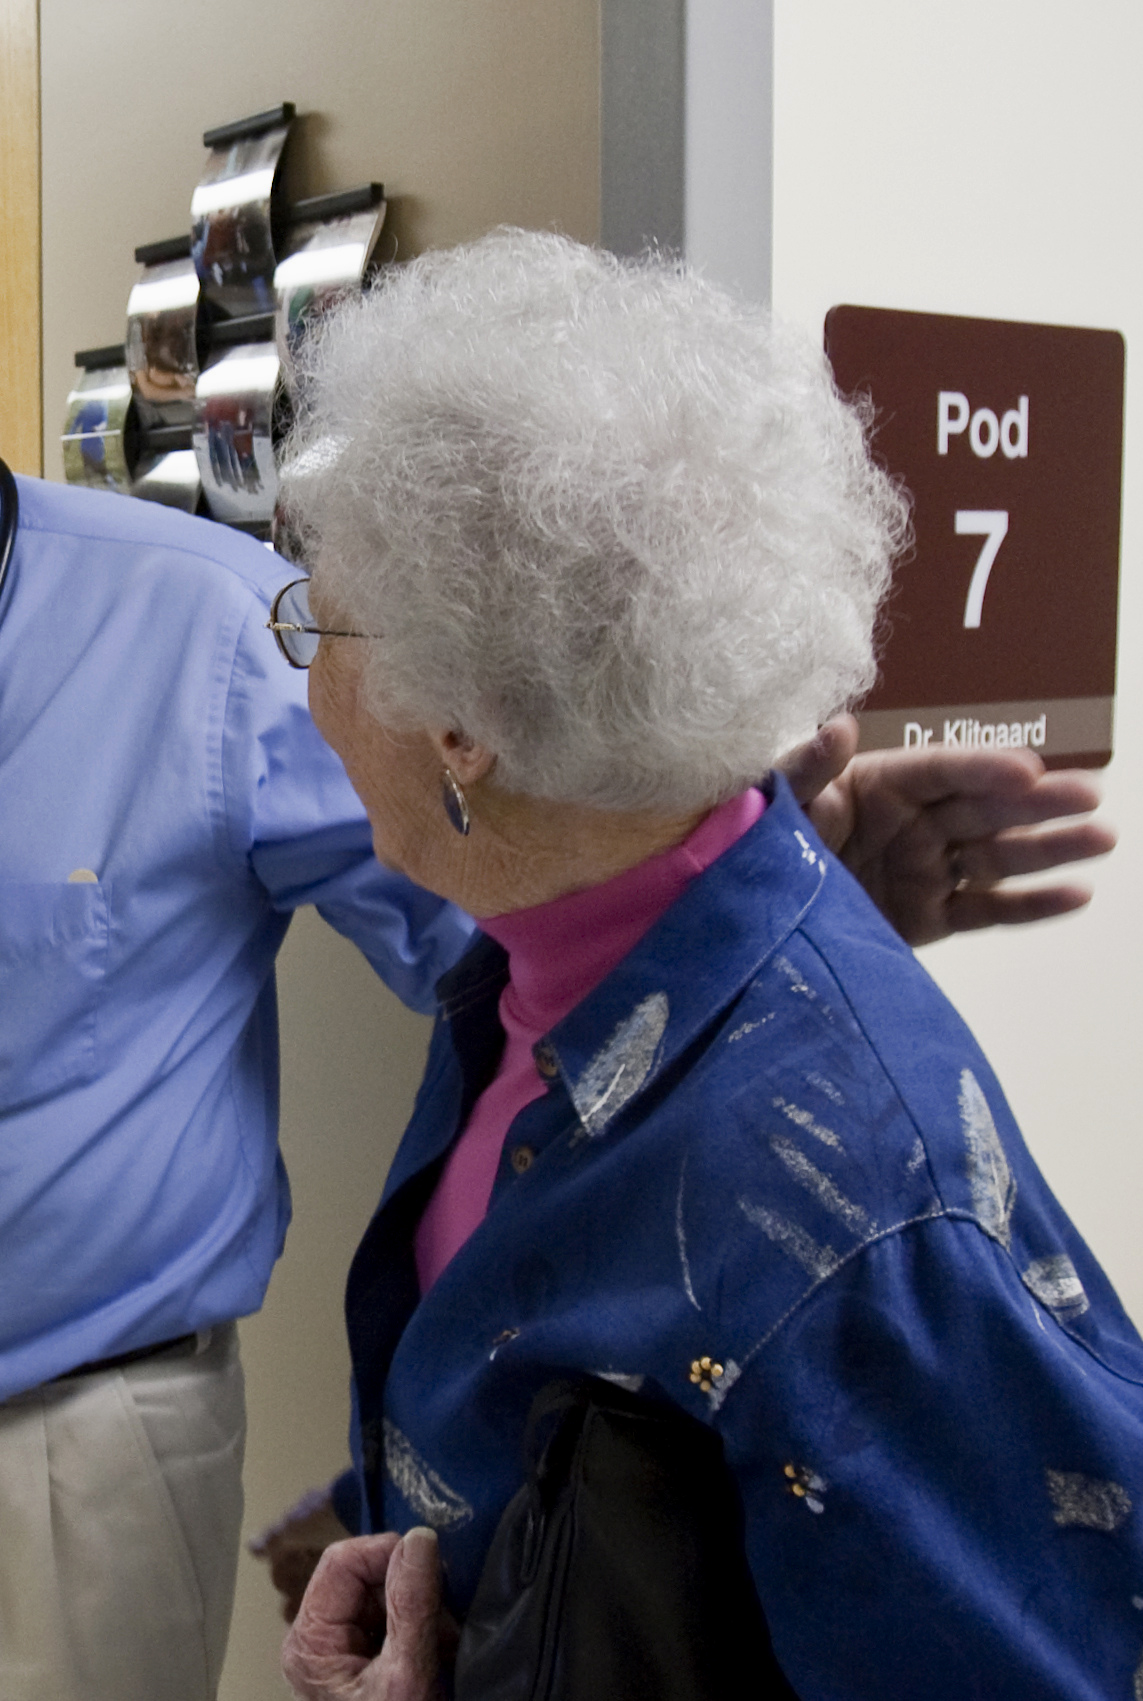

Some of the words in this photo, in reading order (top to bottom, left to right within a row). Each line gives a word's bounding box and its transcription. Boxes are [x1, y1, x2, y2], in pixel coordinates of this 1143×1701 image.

[937, 390, 1030, 459] Pod
[954, 510, 1009, 629] 7
[943, 713, 1047, 750] Klitgaard
